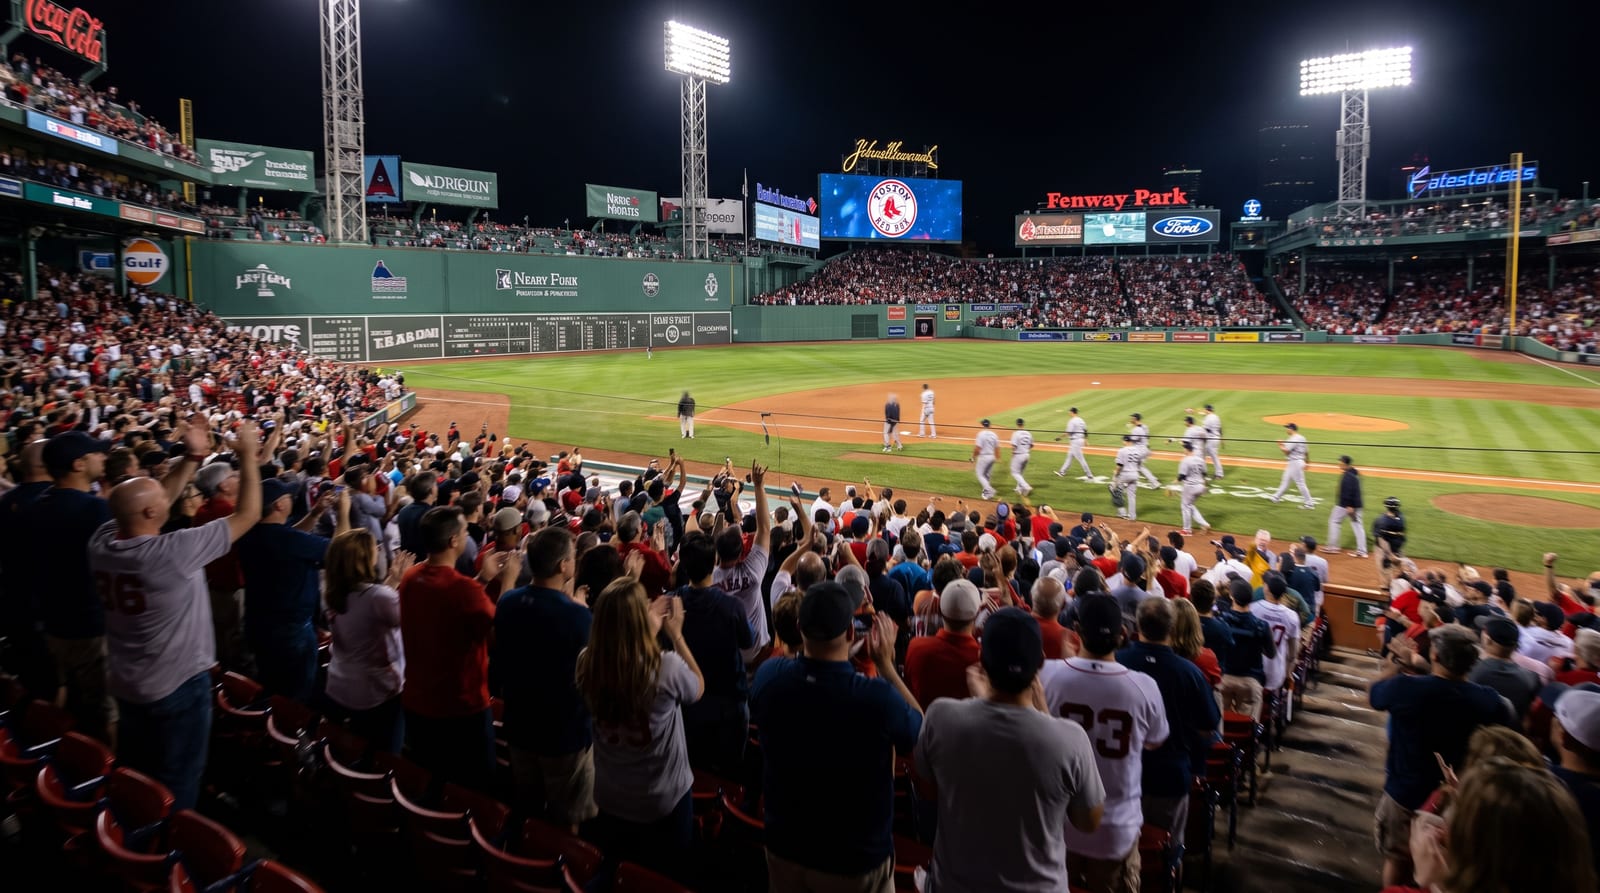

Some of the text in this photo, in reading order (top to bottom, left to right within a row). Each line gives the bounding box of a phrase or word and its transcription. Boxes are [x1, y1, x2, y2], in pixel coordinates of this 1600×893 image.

[1047, 187, 1188, 211] Fenway Park
[1164, 218, 1201, 234] Ford
[126, 256, 162, 269] Gulf
